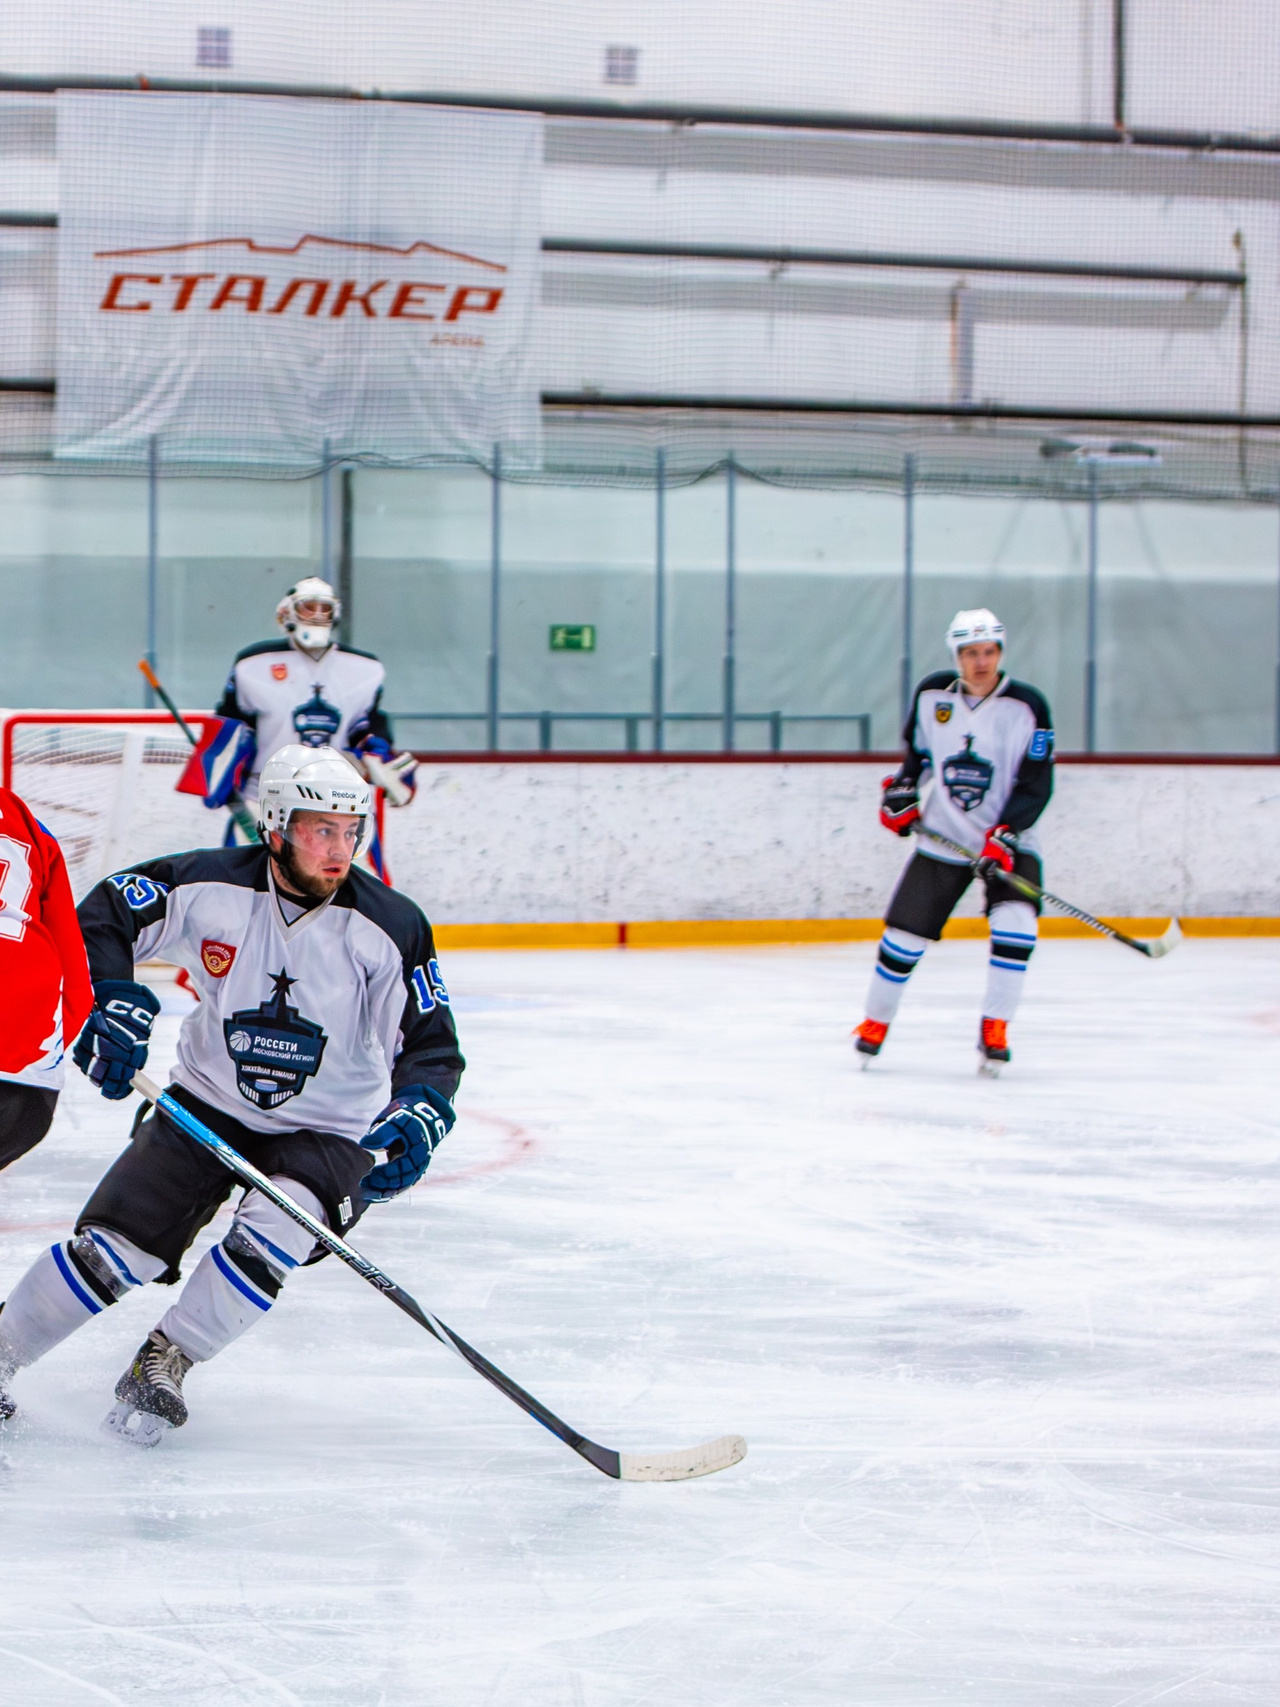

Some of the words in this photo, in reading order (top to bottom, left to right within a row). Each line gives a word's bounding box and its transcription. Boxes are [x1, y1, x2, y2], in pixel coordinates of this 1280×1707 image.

[99, 272, 504, 322] СТАЛКЕР
[331, 790, 357, 799] Reebok
[254, 1036, 298, 1052] РОССЕТИ
[253, 1047, 291, 1060] МОСКОВСКИЙ
